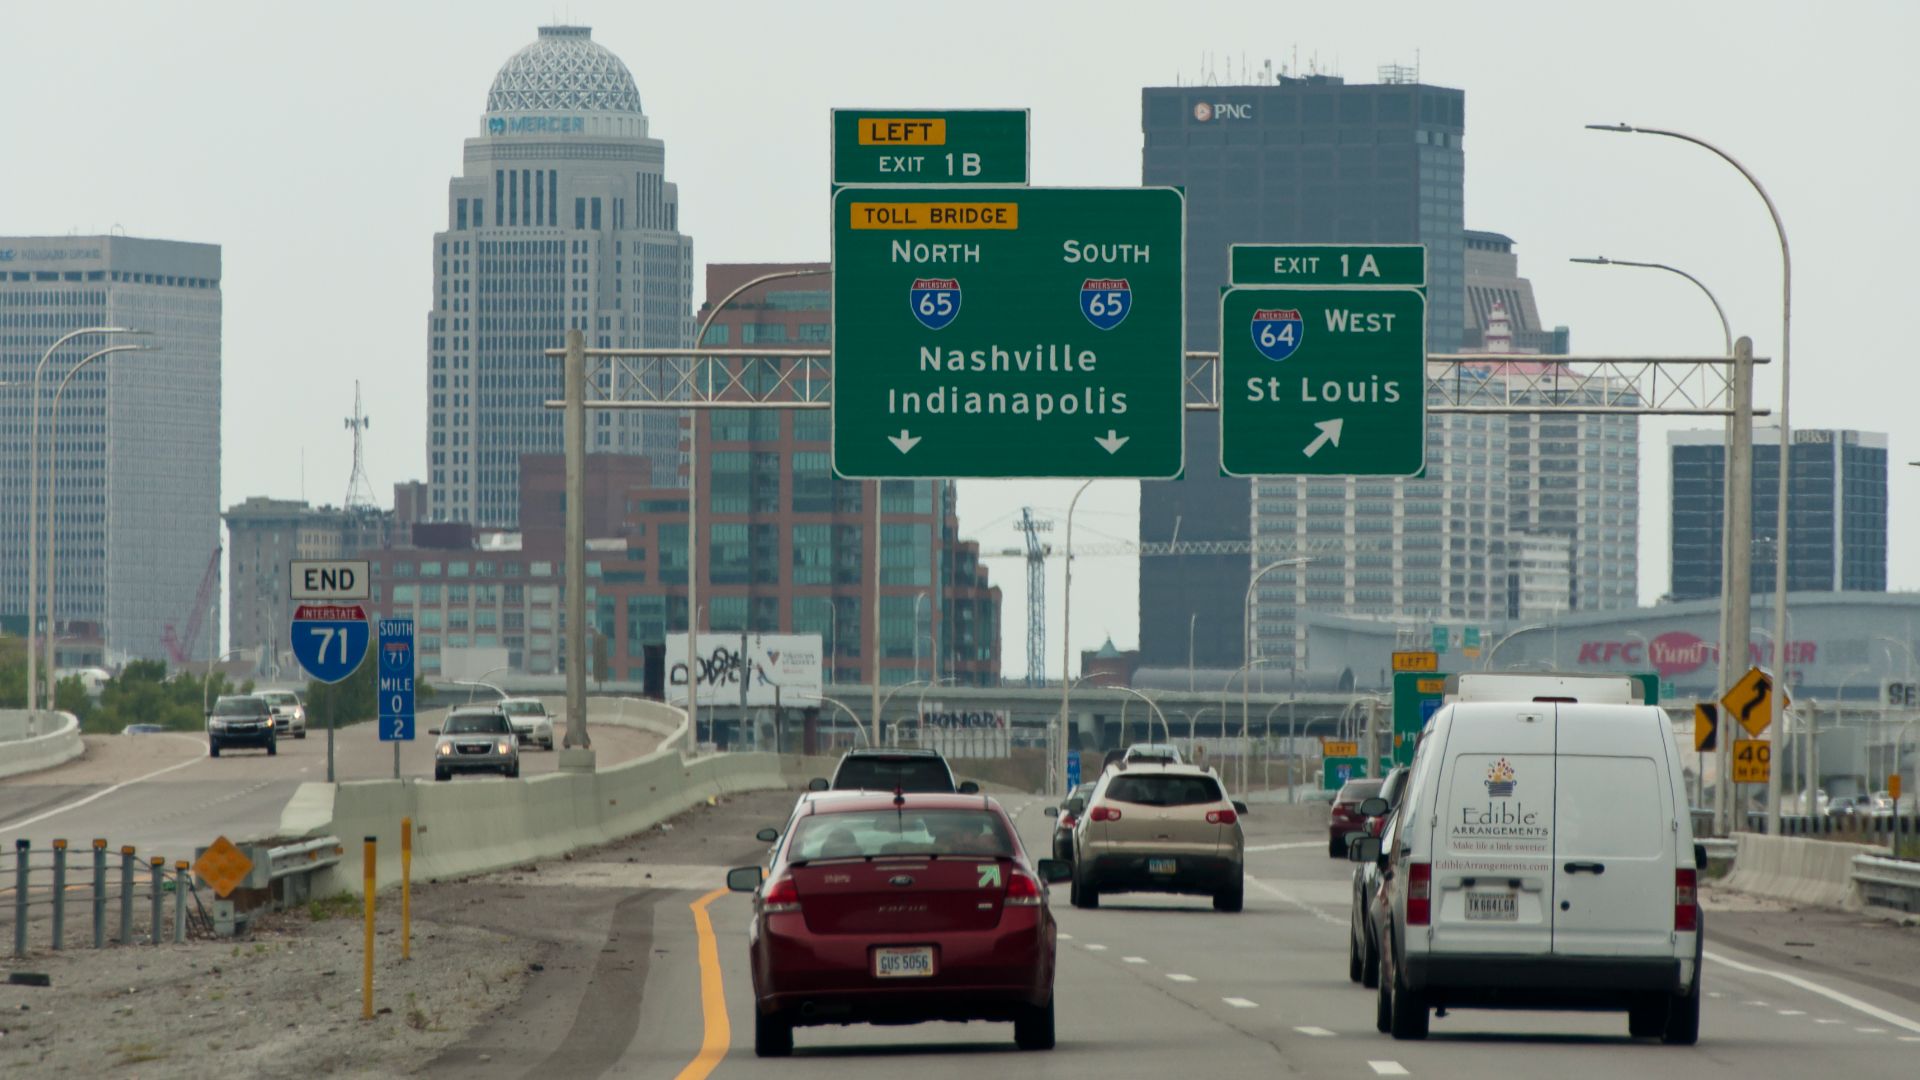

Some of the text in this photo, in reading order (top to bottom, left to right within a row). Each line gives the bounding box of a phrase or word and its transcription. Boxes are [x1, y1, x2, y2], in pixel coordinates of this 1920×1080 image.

[1214, 103, 1252, 119] PNC
[509, 116, 585, 133] MERCER
[872, 123, 932, 141] LEFT
[879, 153, 981, 176] EXIT 1B
[864, 208, 1007, 224] TOLL BRIDGE
[1274, 254, 1381, 277] EXIT 1A
[917, 281, 954, 289] INTERSTATE
[1088, 281, 1124, 289] INTERSTATE
[919, 292, 952, 316] 65
[1089, 292, 1123, 317] 65
[1259, 312, 1295, 320] INTERSTATE
[1260, 323, 1294, 348] 64
[920, 344, 1097, 372] Nashville
[1247, 375, 1401, 403] St Louis
[889, 386, 1128, 420] Indianapolis
[305, 569, 355, 591] END
[303, 607, 357, 620] INTERSTATE
[380, 622, 413, 637] SOUTH
[310, 627, 348, 665] 71
[1578, 641, 1643, 664] KFC
[1655, 642, 1700, 664] Yum!
[388, 652, 403, 665] 71
[1400, 657, 1429, 667] LEFT
[381, 677, 412, 692] MILE
[1889, 682, 1920, 705] SE
[391, 695, 402, 713] 0
[389, 719, 404, 738] .2
[1738, 746, 1770, 762] 40
[1462, 801, 1535, 825] Edible
[1452, 826, 1549, 836] ARRANGEMENTS
[1453, 841, 1473, 849] Make
[1476, 841, 1487, 849] life
[1496, 842, 1512, 850] little
[1515, 843, 1546, 852] sweeter
[1435, 860, 1549, 871] EdibleArrangements.com
